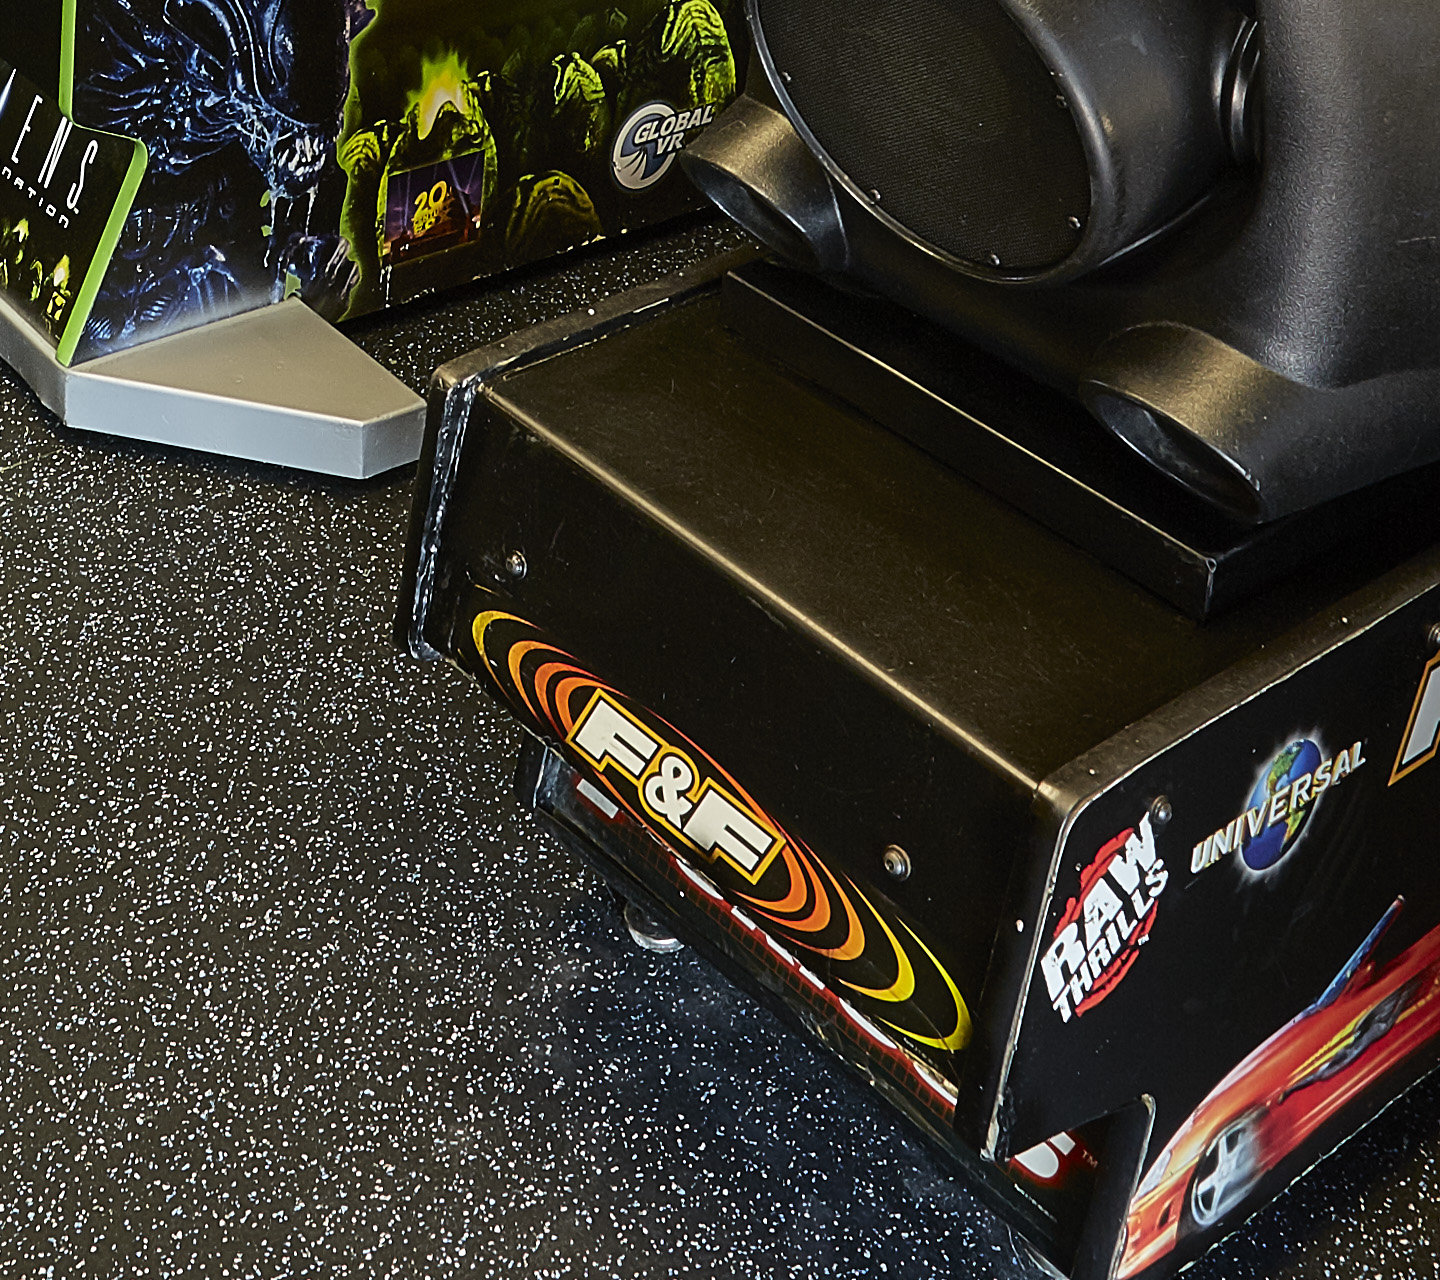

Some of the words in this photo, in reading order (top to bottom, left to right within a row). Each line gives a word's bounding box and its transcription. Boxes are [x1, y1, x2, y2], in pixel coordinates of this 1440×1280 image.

[634, 105, 713, 144] GLOBAL
[656, 132, 685, 155] VR
[574, 698, 774, 870] F&F
[1190, 741, 1367, 874] UNIVERSAL
[1040, 814, 1157, 998] RAW
[1052, 860, 1170, 1023] THRILLS
